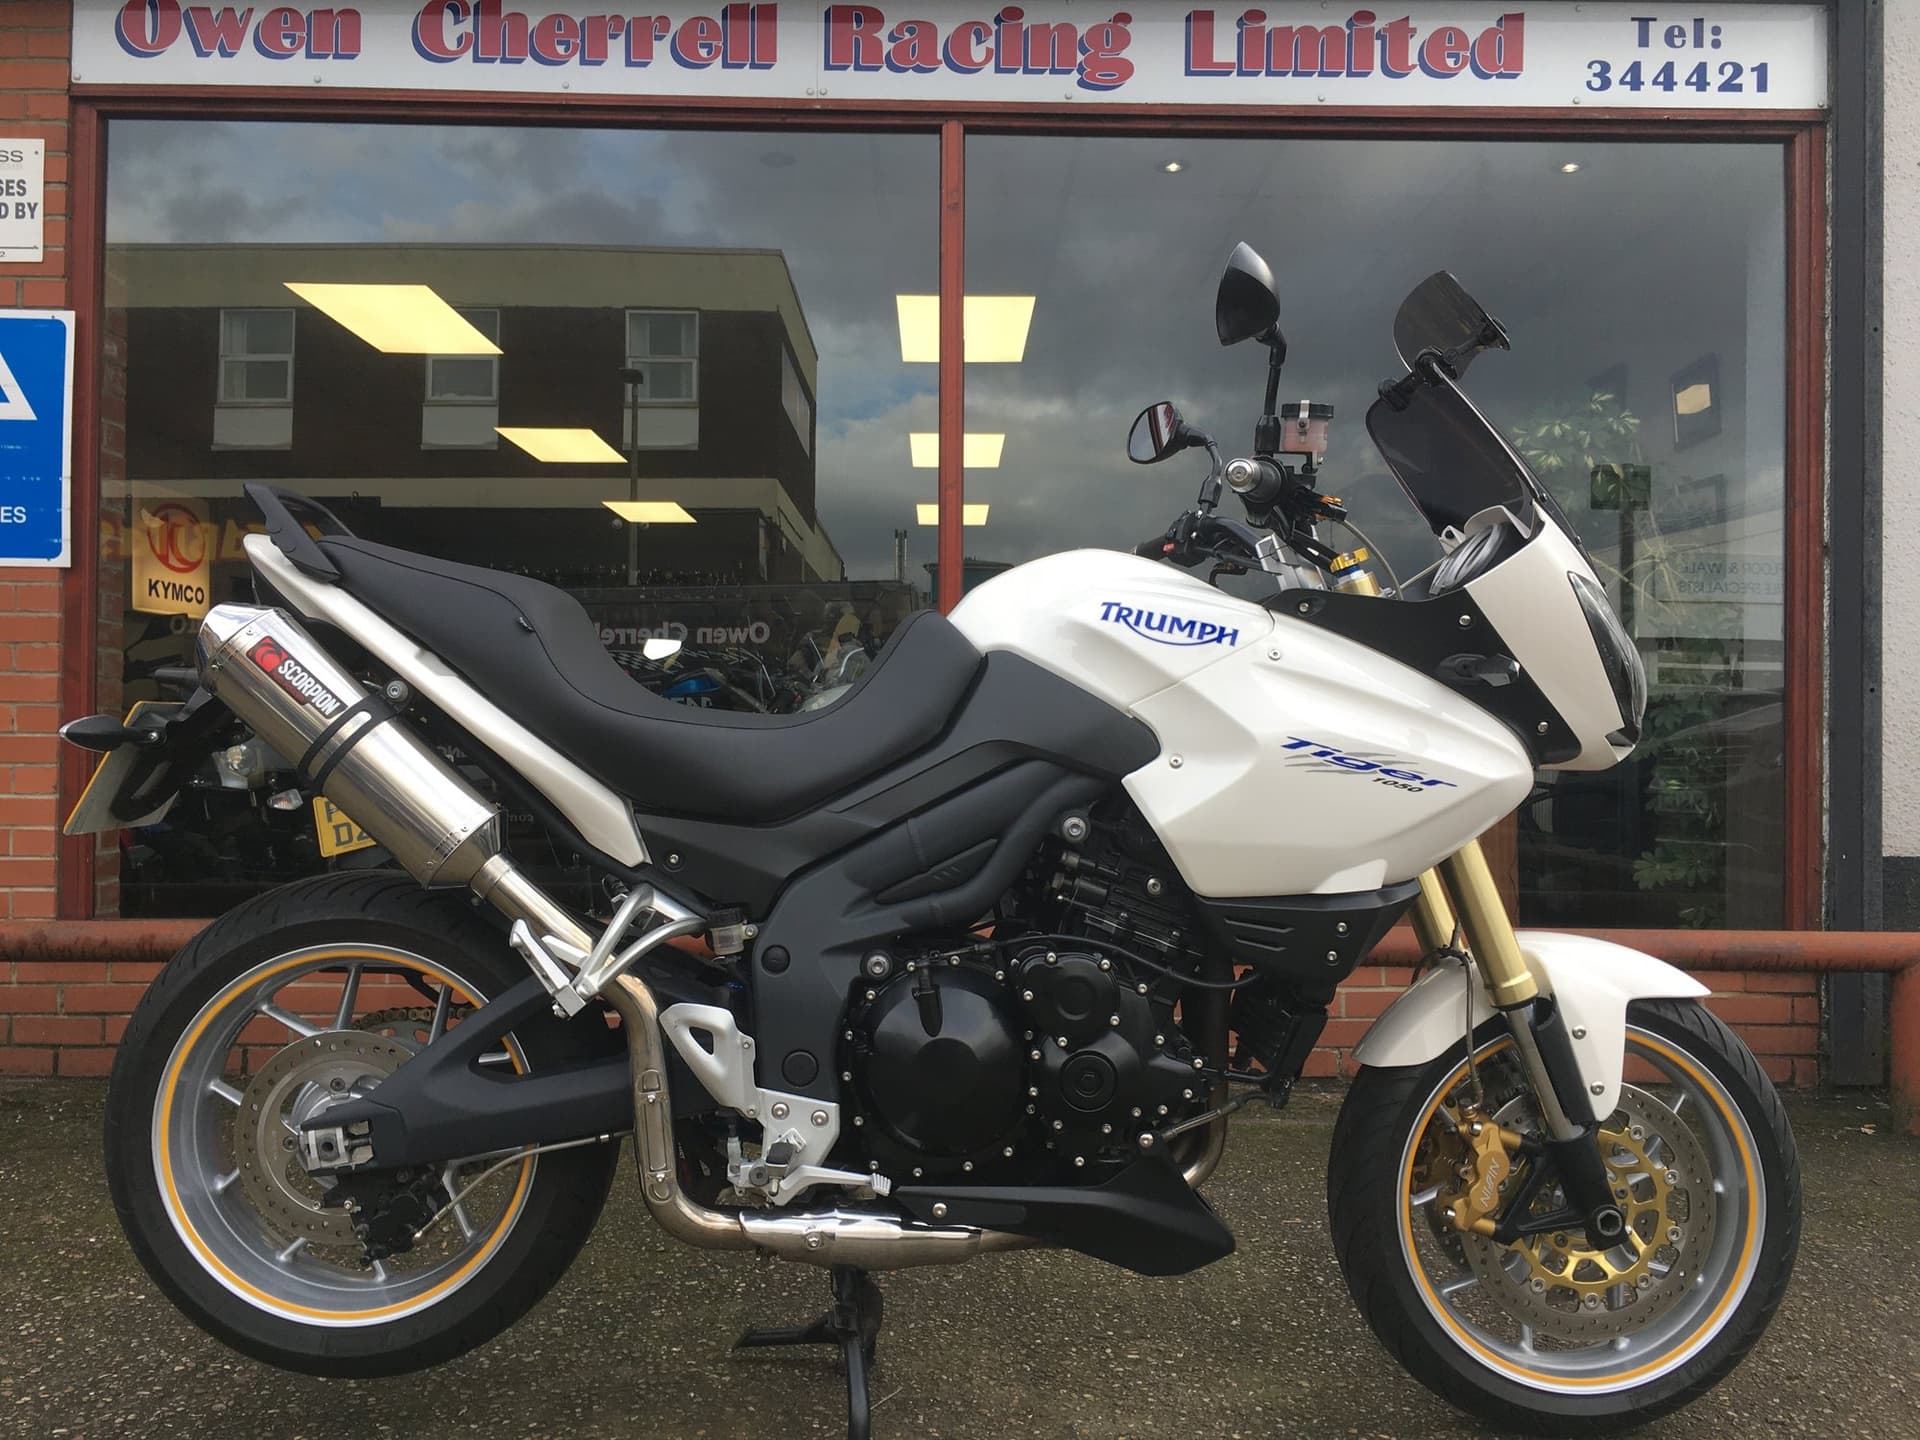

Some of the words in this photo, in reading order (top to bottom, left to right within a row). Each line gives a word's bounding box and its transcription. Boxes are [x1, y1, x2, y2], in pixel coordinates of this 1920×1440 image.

[114, 0, 362, 59] Owen
[411, 0, 778, 69] Cherrell
[824, 4, 1135, 91] Racing
[1184, 8, 1526, 80] Limited
[1630, 17, 1722, 50] Tel:
[1586, 59, 1769, 93] 344421
[15, 202, 39, 220] BY
[148, 578, 205, 605] KYMCO
[1100, 601, 1239, 647] TRIUMPH
[278, 659, 341, 716] SCORPION
[1281, 736, 1458, 788] Tiger
[1371, 776, 1425, 793] 1050
